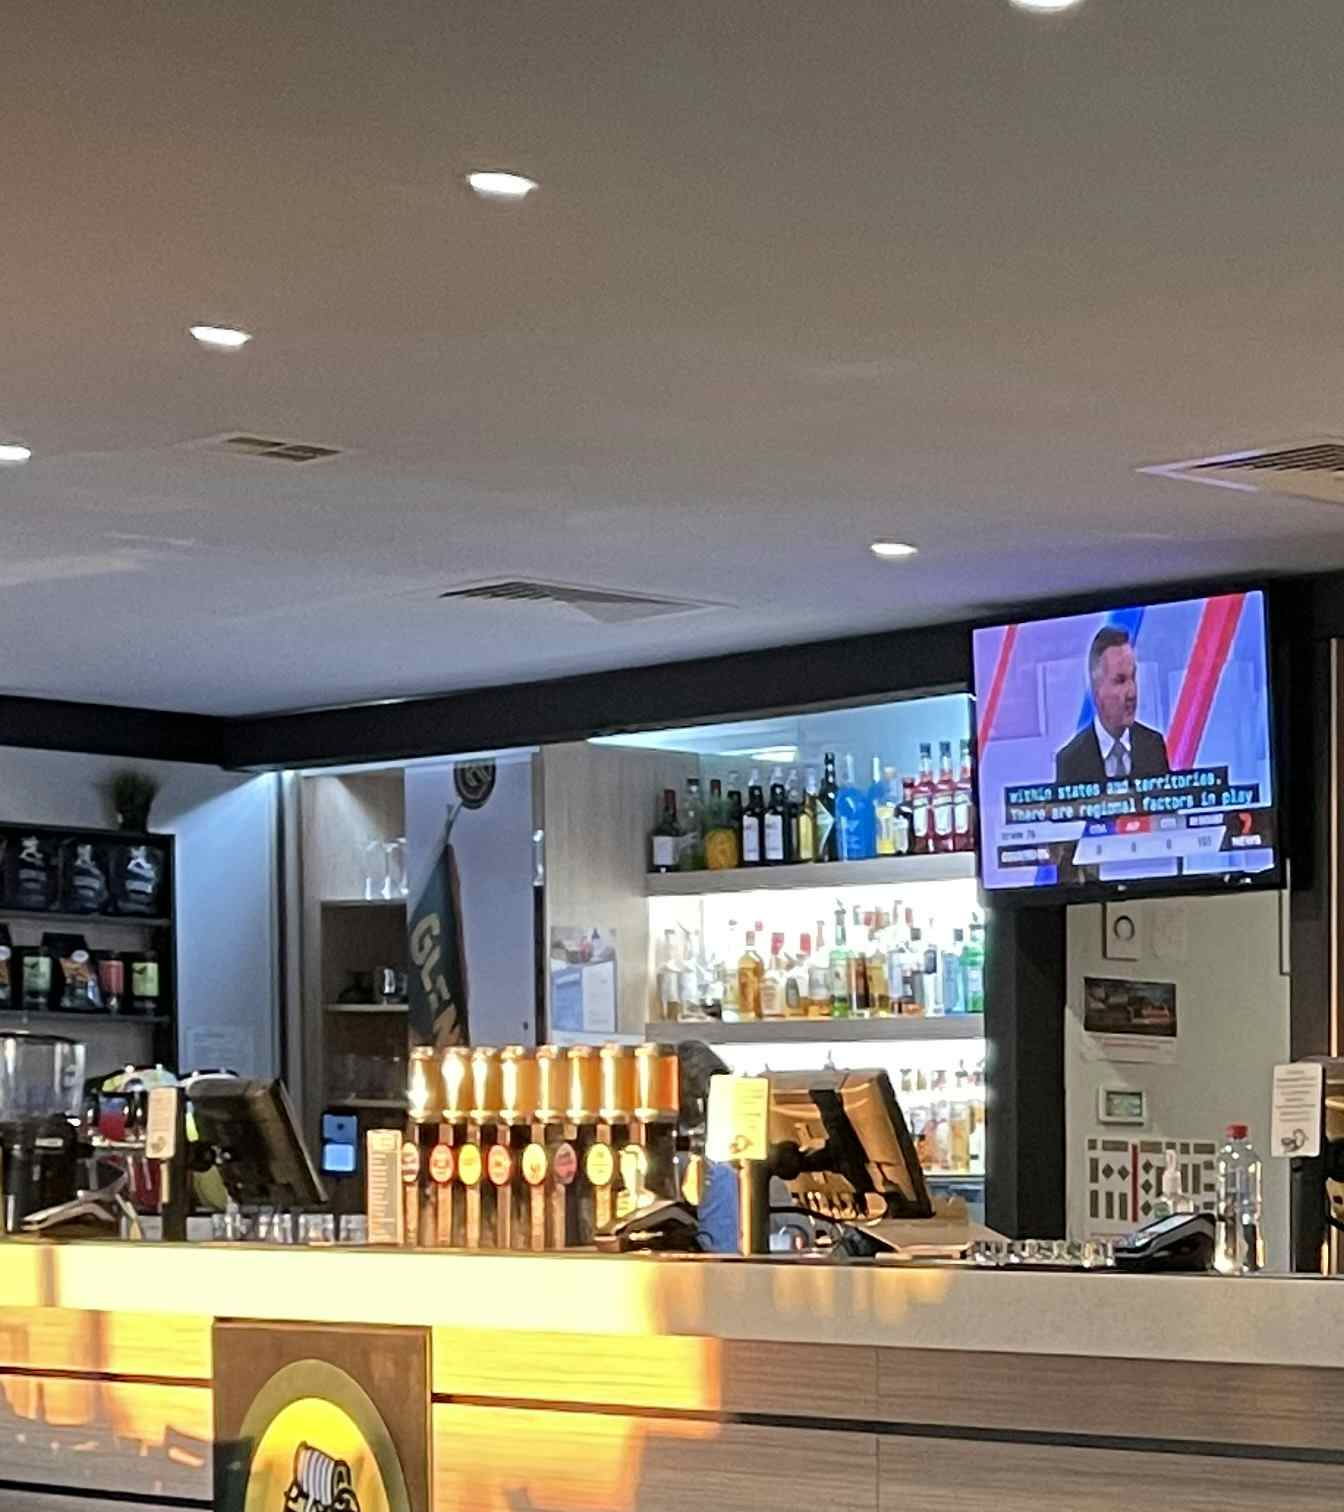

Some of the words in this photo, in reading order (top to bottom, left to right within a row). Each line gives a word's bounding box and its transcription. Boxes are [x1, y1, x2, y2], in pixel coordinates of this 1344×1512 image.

[1058, 783, 1100, 799] states
[1051, 805, 1073, 819] are
[1143, 793, 1194, 811] factors
[1201, 792, 1216, 805] in
[1222, 789, 1253, 806] play
